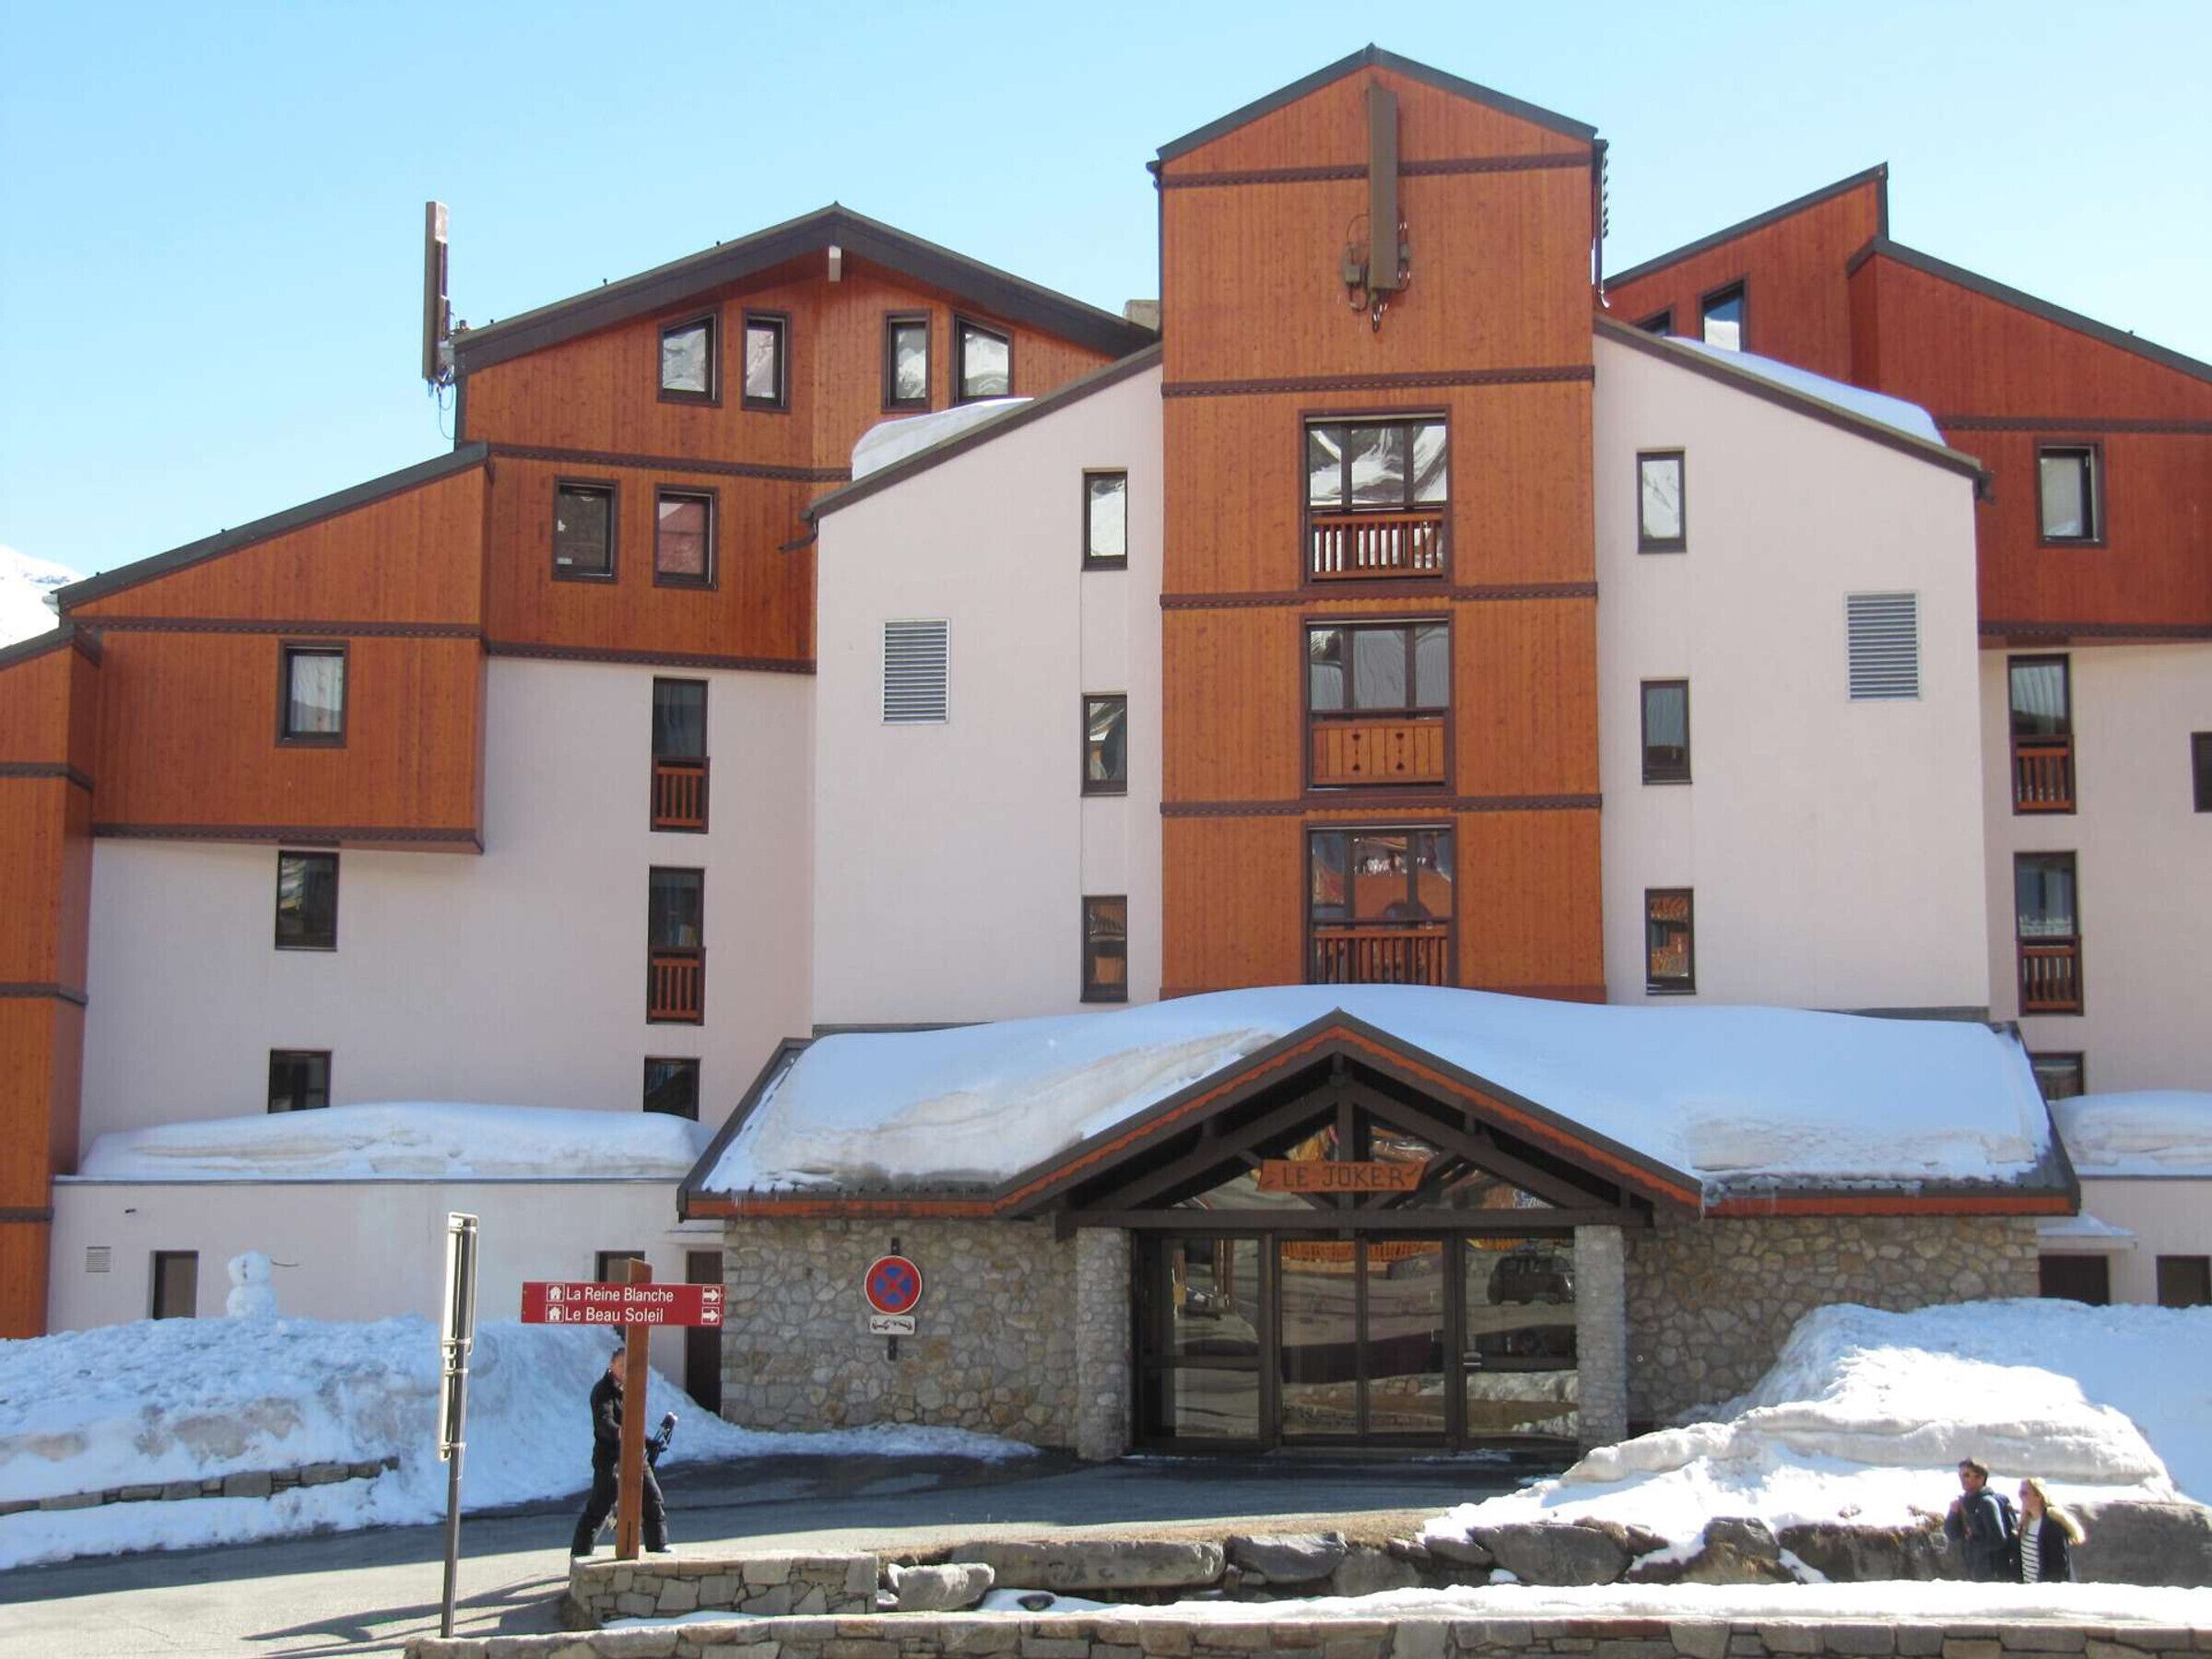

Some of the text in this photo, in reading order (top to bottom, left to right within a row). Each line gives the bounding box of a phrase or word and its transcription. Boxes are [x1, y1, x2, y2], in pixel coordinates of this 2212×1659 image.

[1283, 1166, 1405, 1187] LE JOKER
[566, 1287, 674, 1302] La Reine Blanche
[565, 1307, 664, 1323] Le Beau Soleil
